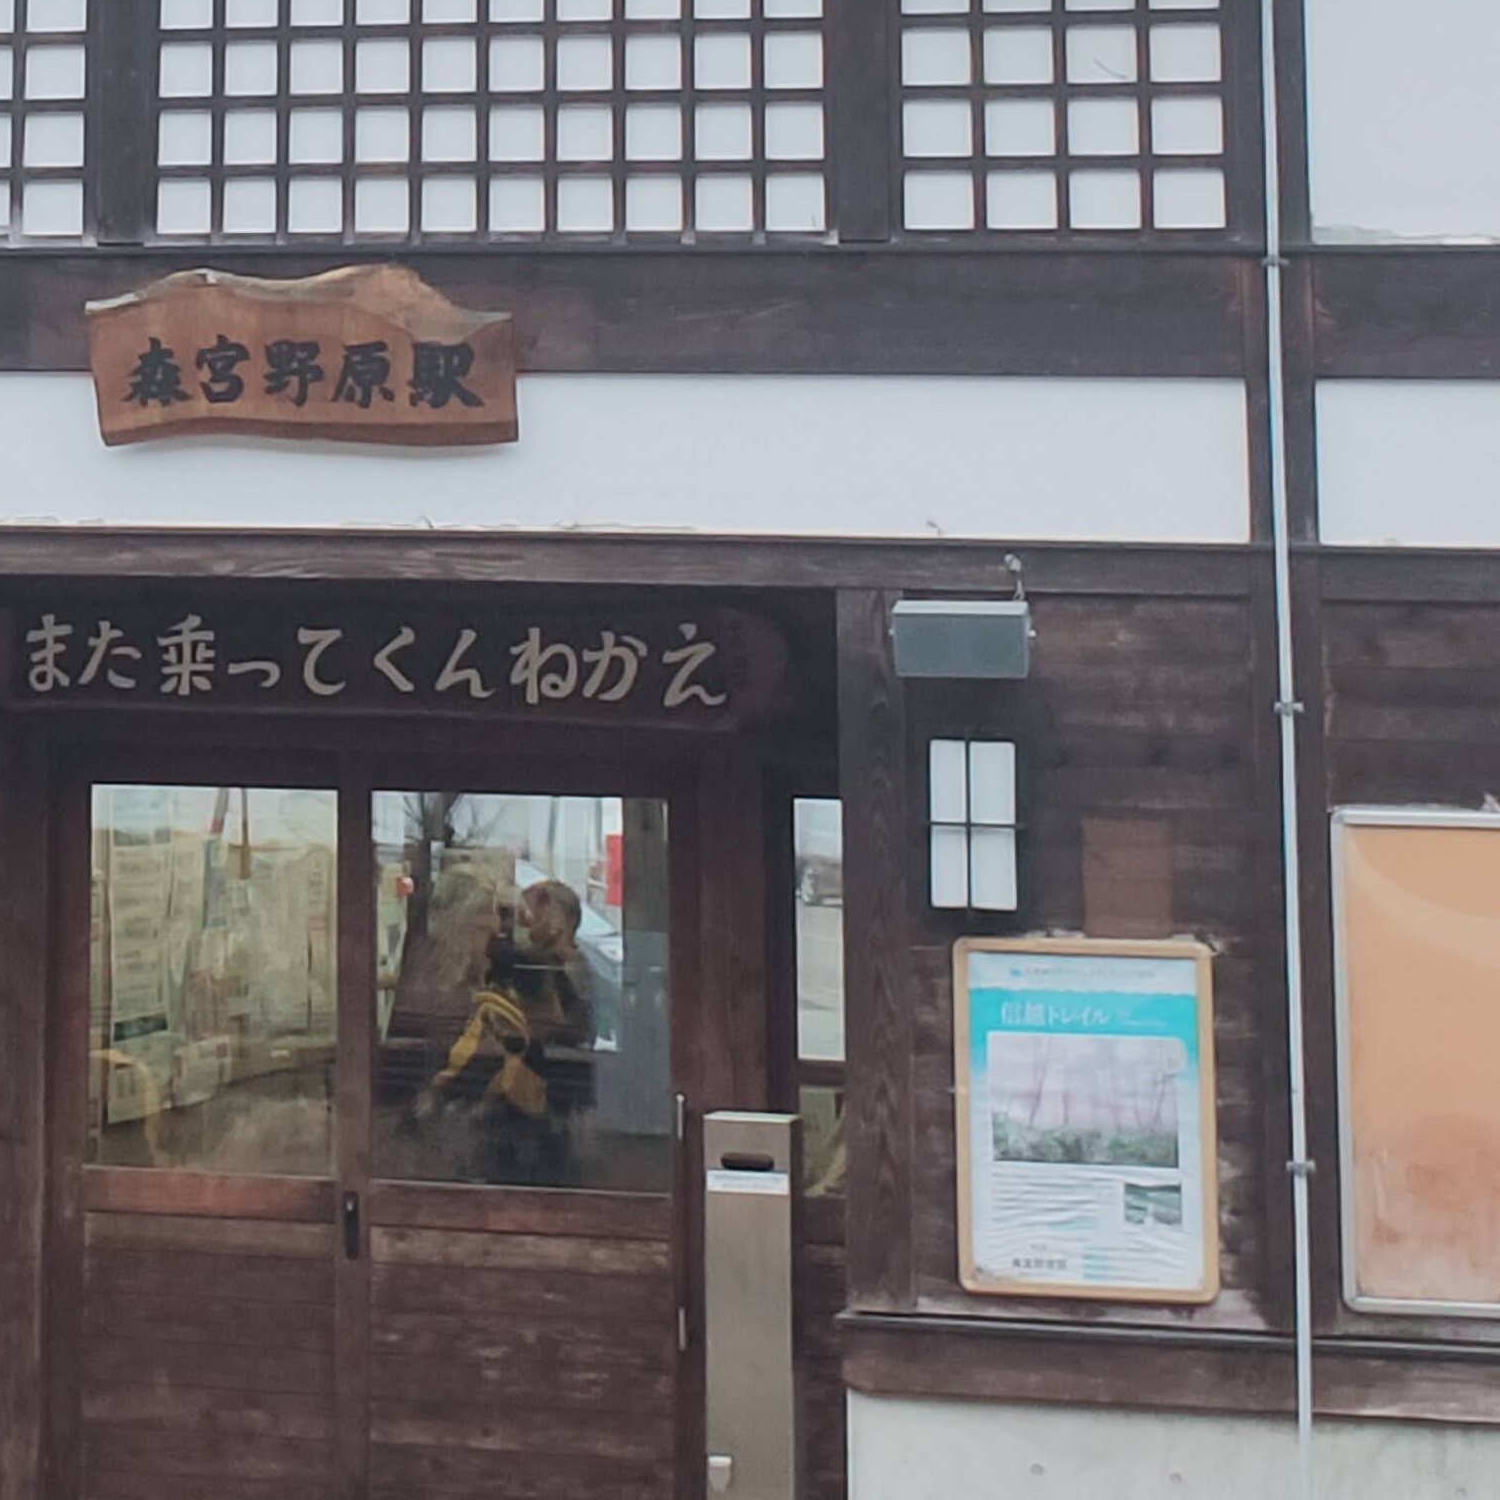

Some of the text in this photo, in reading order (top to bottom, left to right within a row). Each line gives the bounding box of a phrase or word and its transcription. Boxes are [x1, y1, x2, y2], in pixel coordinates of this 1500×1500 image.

[124, 333, 486, 410] 森宮野原駅
[25, 613, 728, 706] また乗ってくんねかえ
